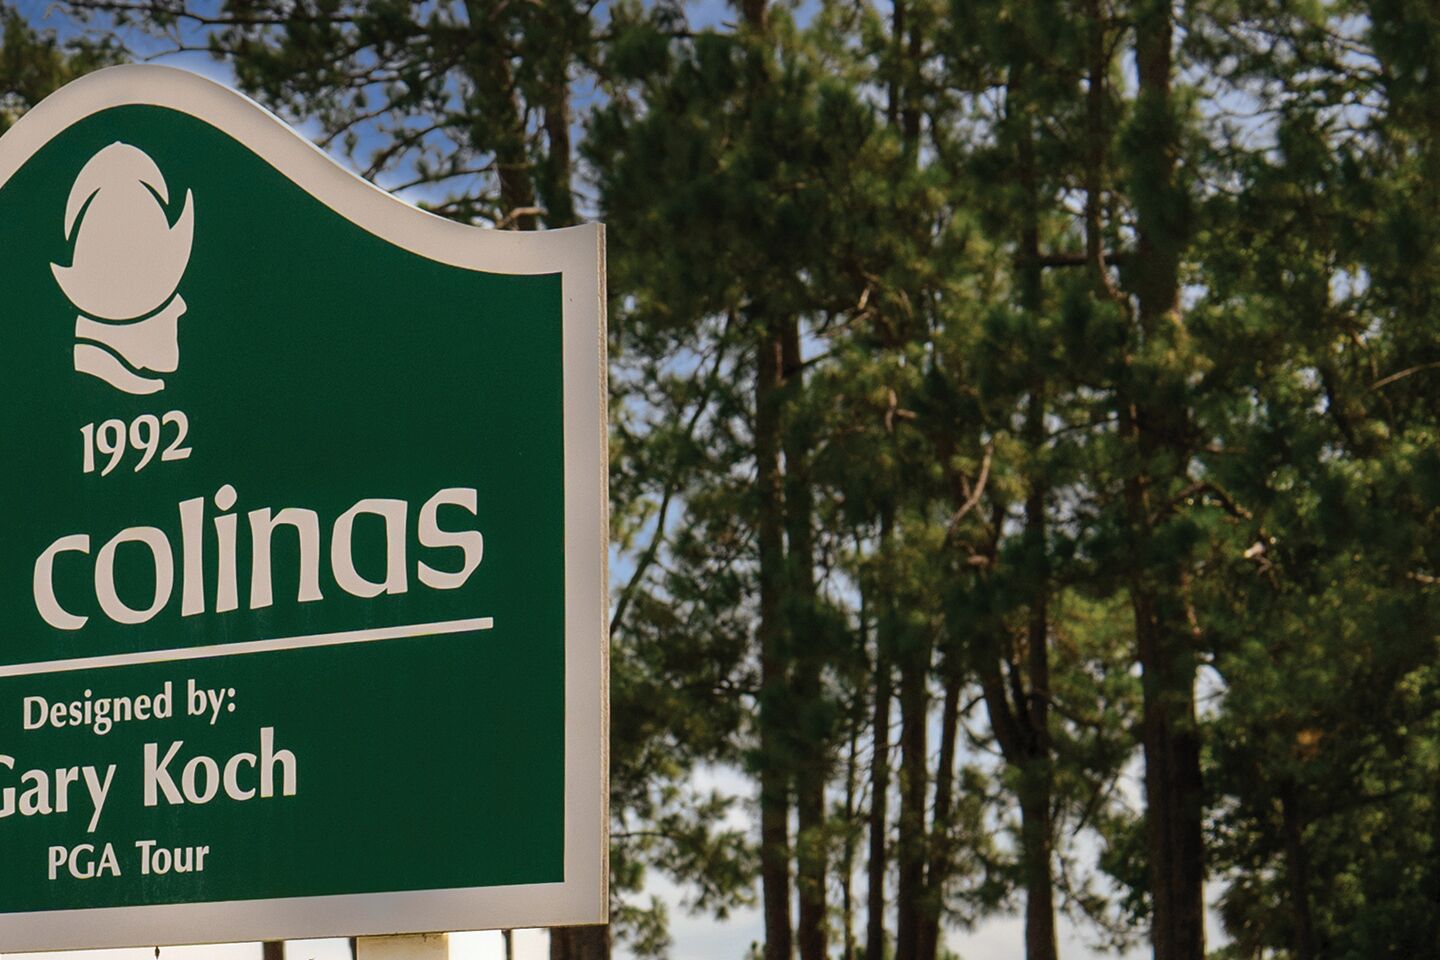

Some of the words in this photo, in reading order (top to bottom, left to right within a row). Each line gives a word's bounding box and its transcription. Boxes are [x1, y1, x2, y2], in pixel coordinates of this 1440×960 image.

[80, 411, 192, 476] 1992
[24, 681, 172, 735] Designed
[188, 679, 235, 724] by:
[144, 727, 296, 806] Koch
[49, 843, 121, 879] PGA
[136, 840, 209, 874] Tour
